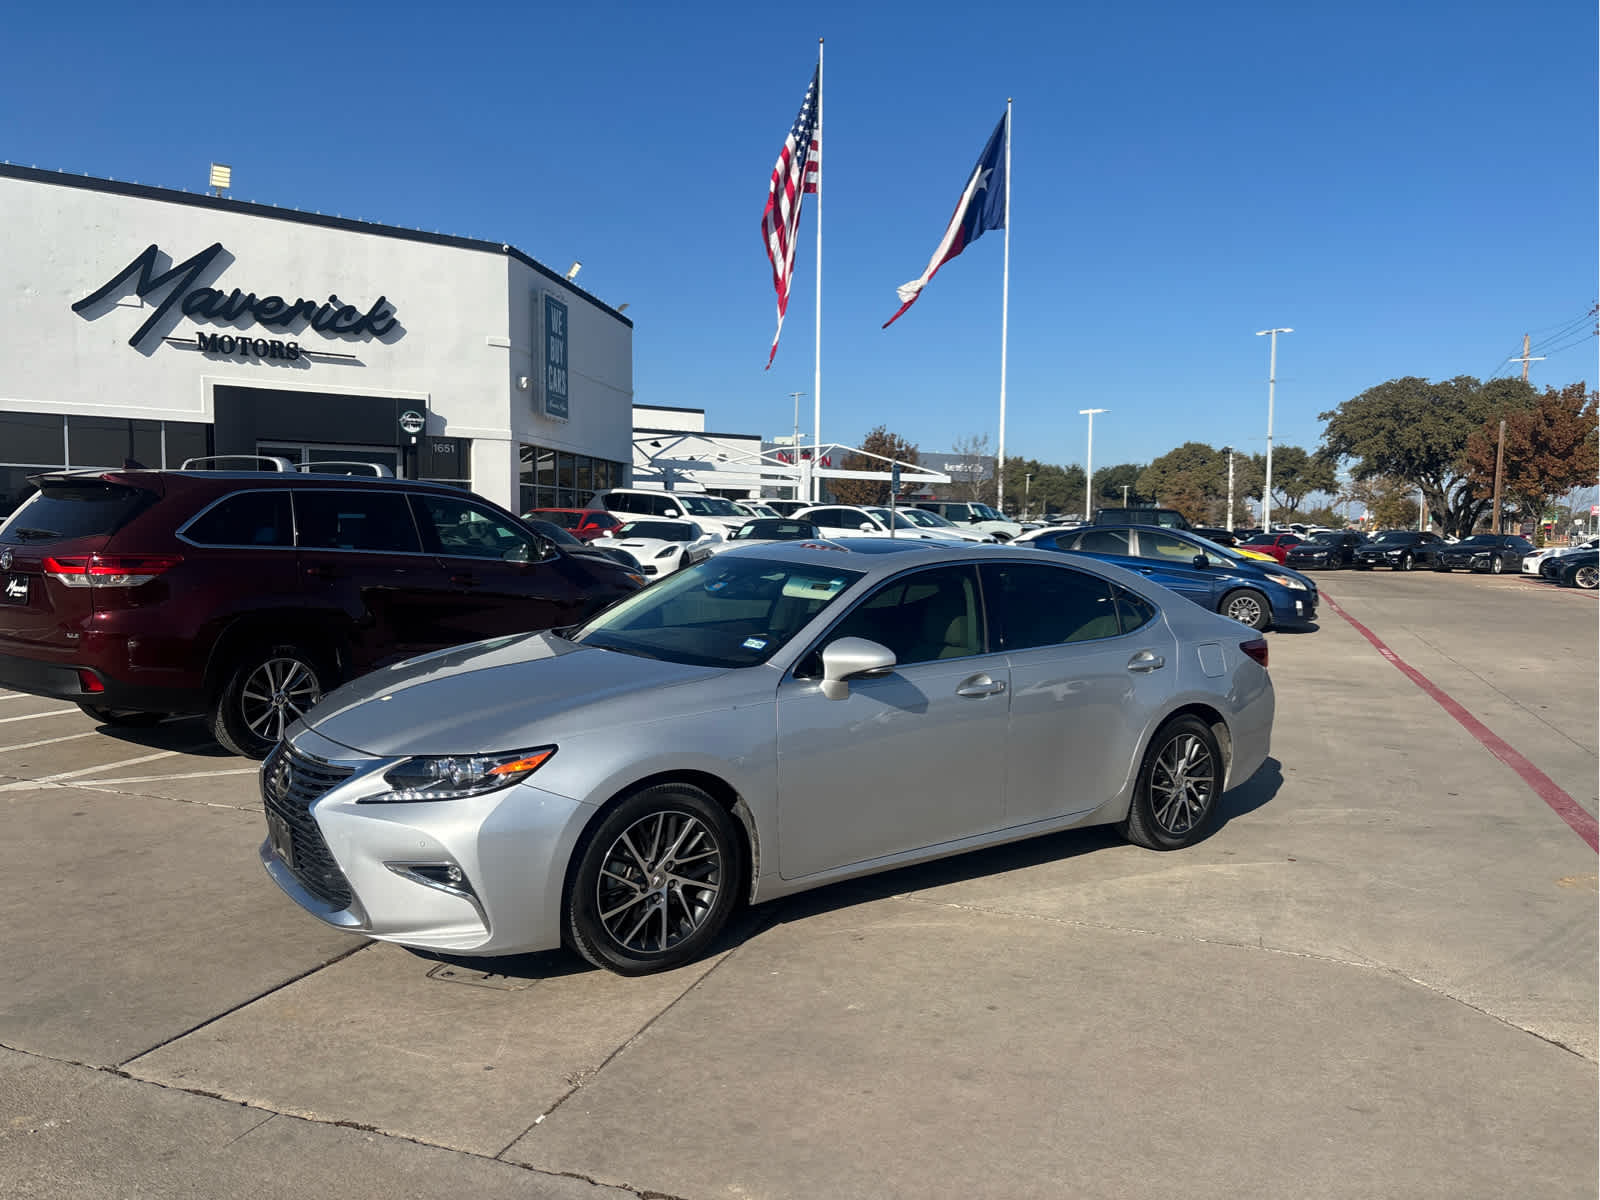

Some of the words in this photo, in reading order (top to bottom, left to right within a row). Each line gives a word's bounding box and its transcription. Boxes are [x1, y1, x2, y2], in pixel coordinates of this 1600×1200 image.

[71, 242, 397, 347] Maverick
[550, 304, 563, 336] WE
[195, 332, 300, 361] MOTORS
[550, 335, 564, 366] BUY
[548, 363, 566, 395] CARS
[433, 443, 455, 453] 1651
